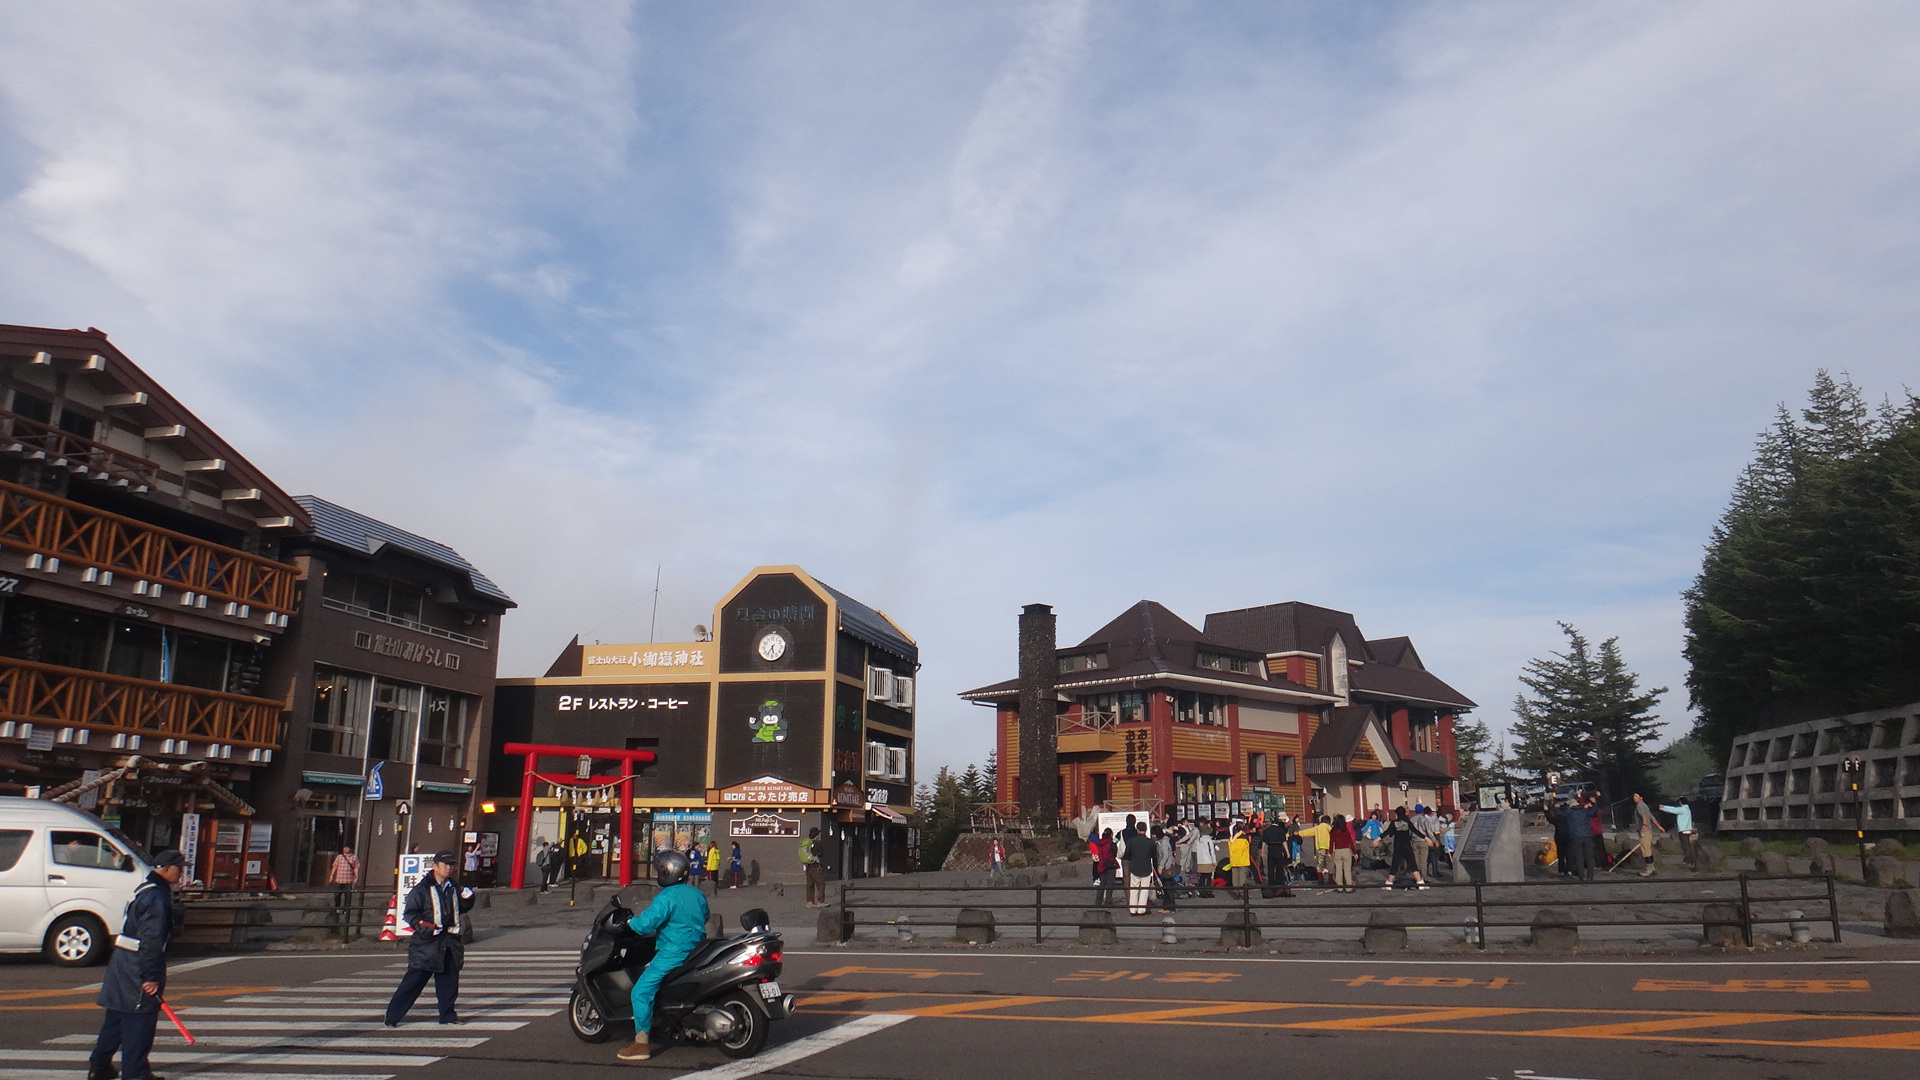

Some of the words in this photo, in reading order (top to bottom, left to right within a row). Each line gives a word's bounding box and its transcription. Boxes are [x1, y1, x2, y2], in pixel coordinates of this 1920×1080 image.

[559, 696, 583, 711] 2F
[589, 698, 688, 710] レストラン・コーヒー
[1138, 729, 1149, 774] おみやげ
[1845, 760, 1850, 771] F
[1551, 776, 1557, 784] E
[747, 792, 808, 802] こみたけ売店
[399, 804, 408, 814] A
[404, 858, 418, 873] P
